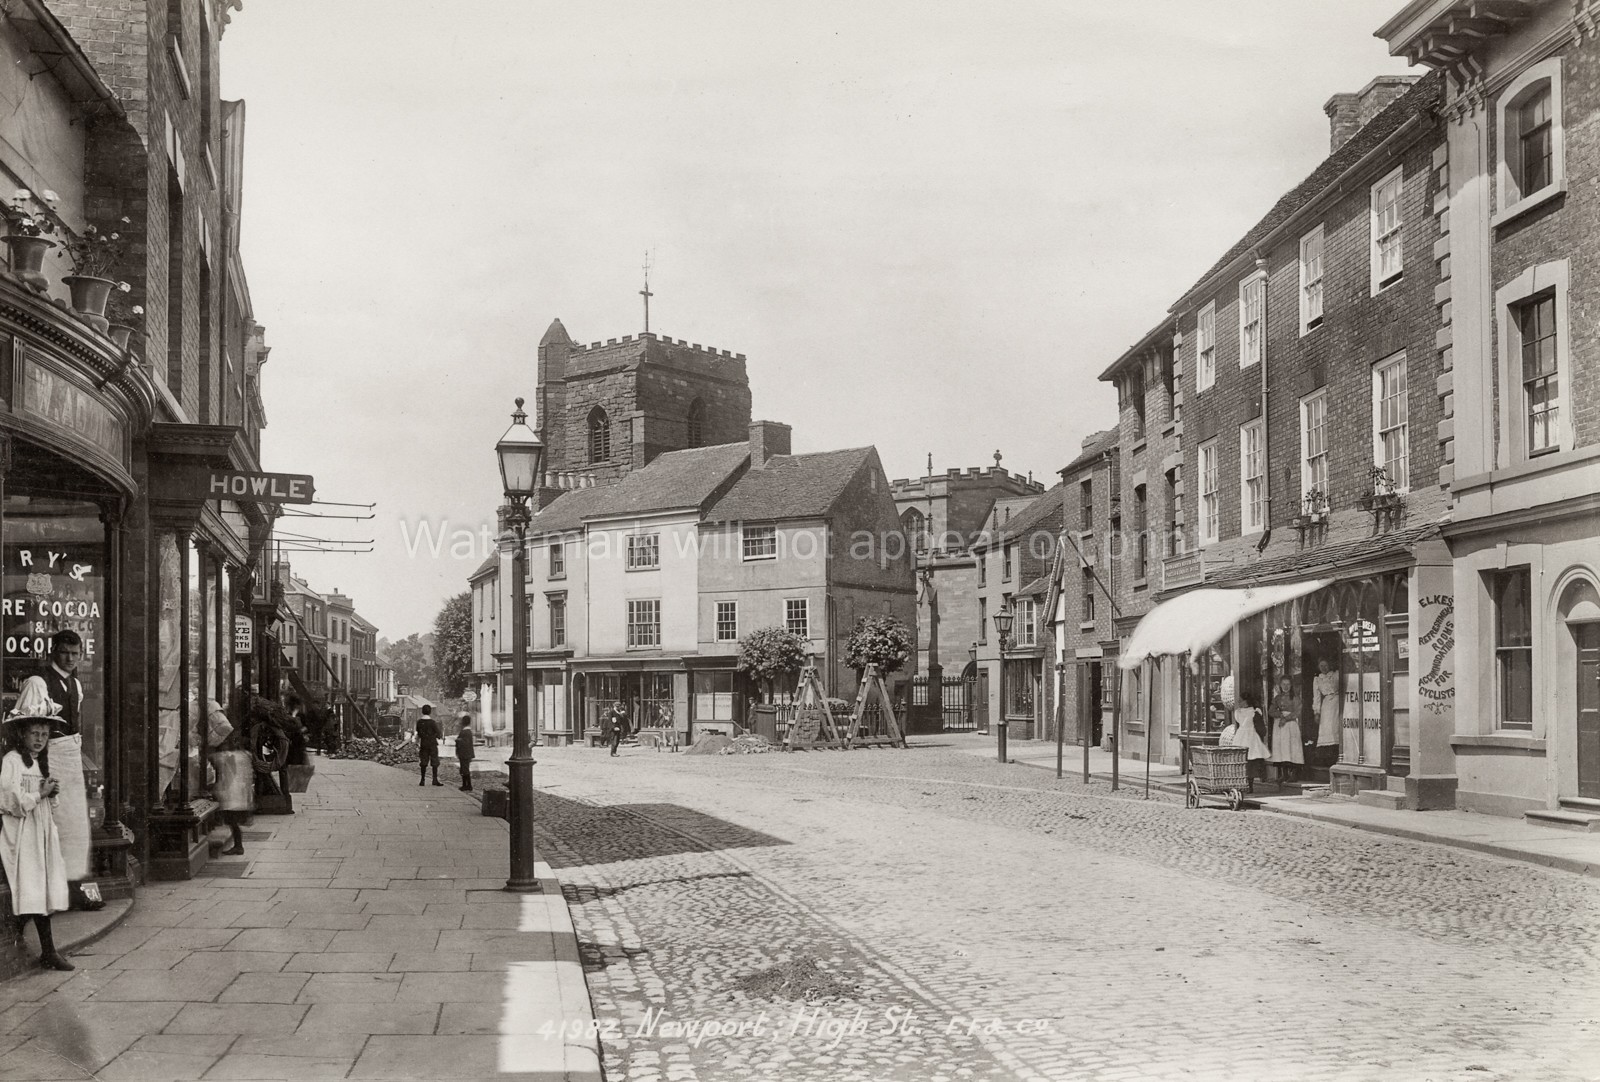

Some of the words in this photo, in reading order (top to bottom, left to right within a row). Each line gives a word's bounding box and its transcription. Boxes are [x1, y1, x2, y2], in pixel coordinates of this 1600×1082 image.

[210, 474, 306, 499] HOWLE
[38, 600, 101, 618] COCOA
[34, 621, 45, 634] &
[1431, 620, 1455, 652] ROOMS
[1434, 670, 1453, 687] FOR
[1345, 691, 1359, 703] TEA
[1418, 686, 1456, 700] CYCLISTS
[1364, 718, 1382, 730] ROOMS
